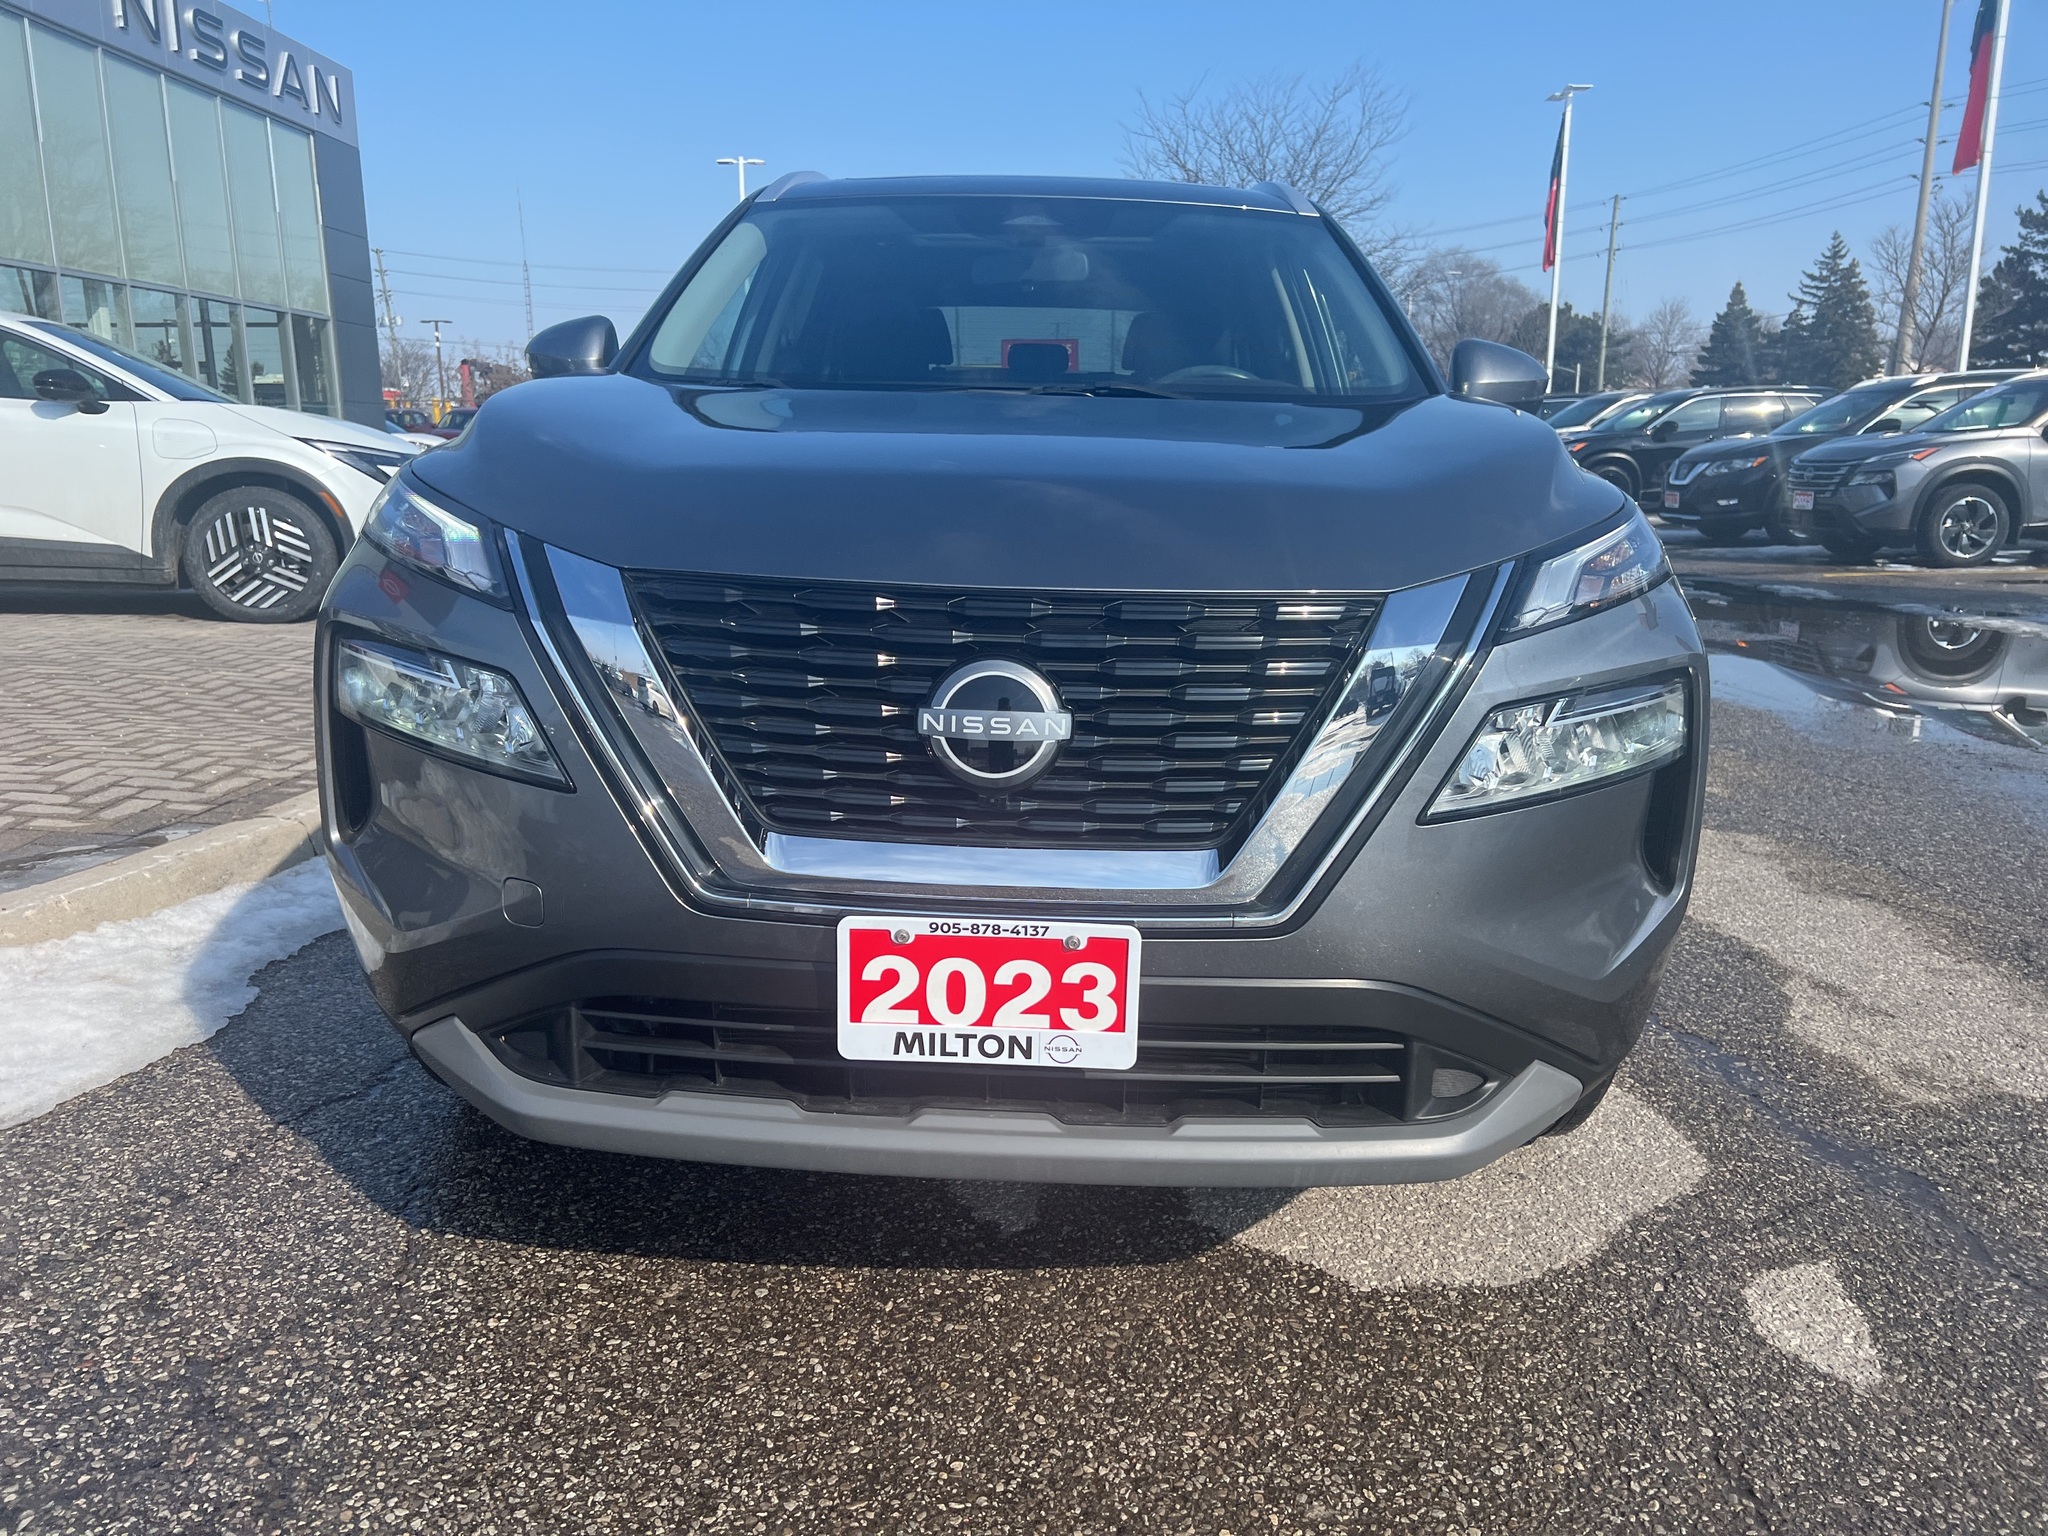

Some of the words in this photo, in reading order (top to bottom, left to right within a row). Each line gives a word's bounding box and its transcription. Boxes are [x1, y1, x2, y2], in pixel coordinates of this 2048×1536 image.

[113, 0, 342, 123] NISSAN
[922, 712, 1067, 736] NISSAN
[928, 922, 1050, 937] 905-878-4137
[860, 954, 1118, 1032] 2023
[893, 1031, 1033, 1060] MILTON
[1043, 1045, 1083, 1053] NISSAN
